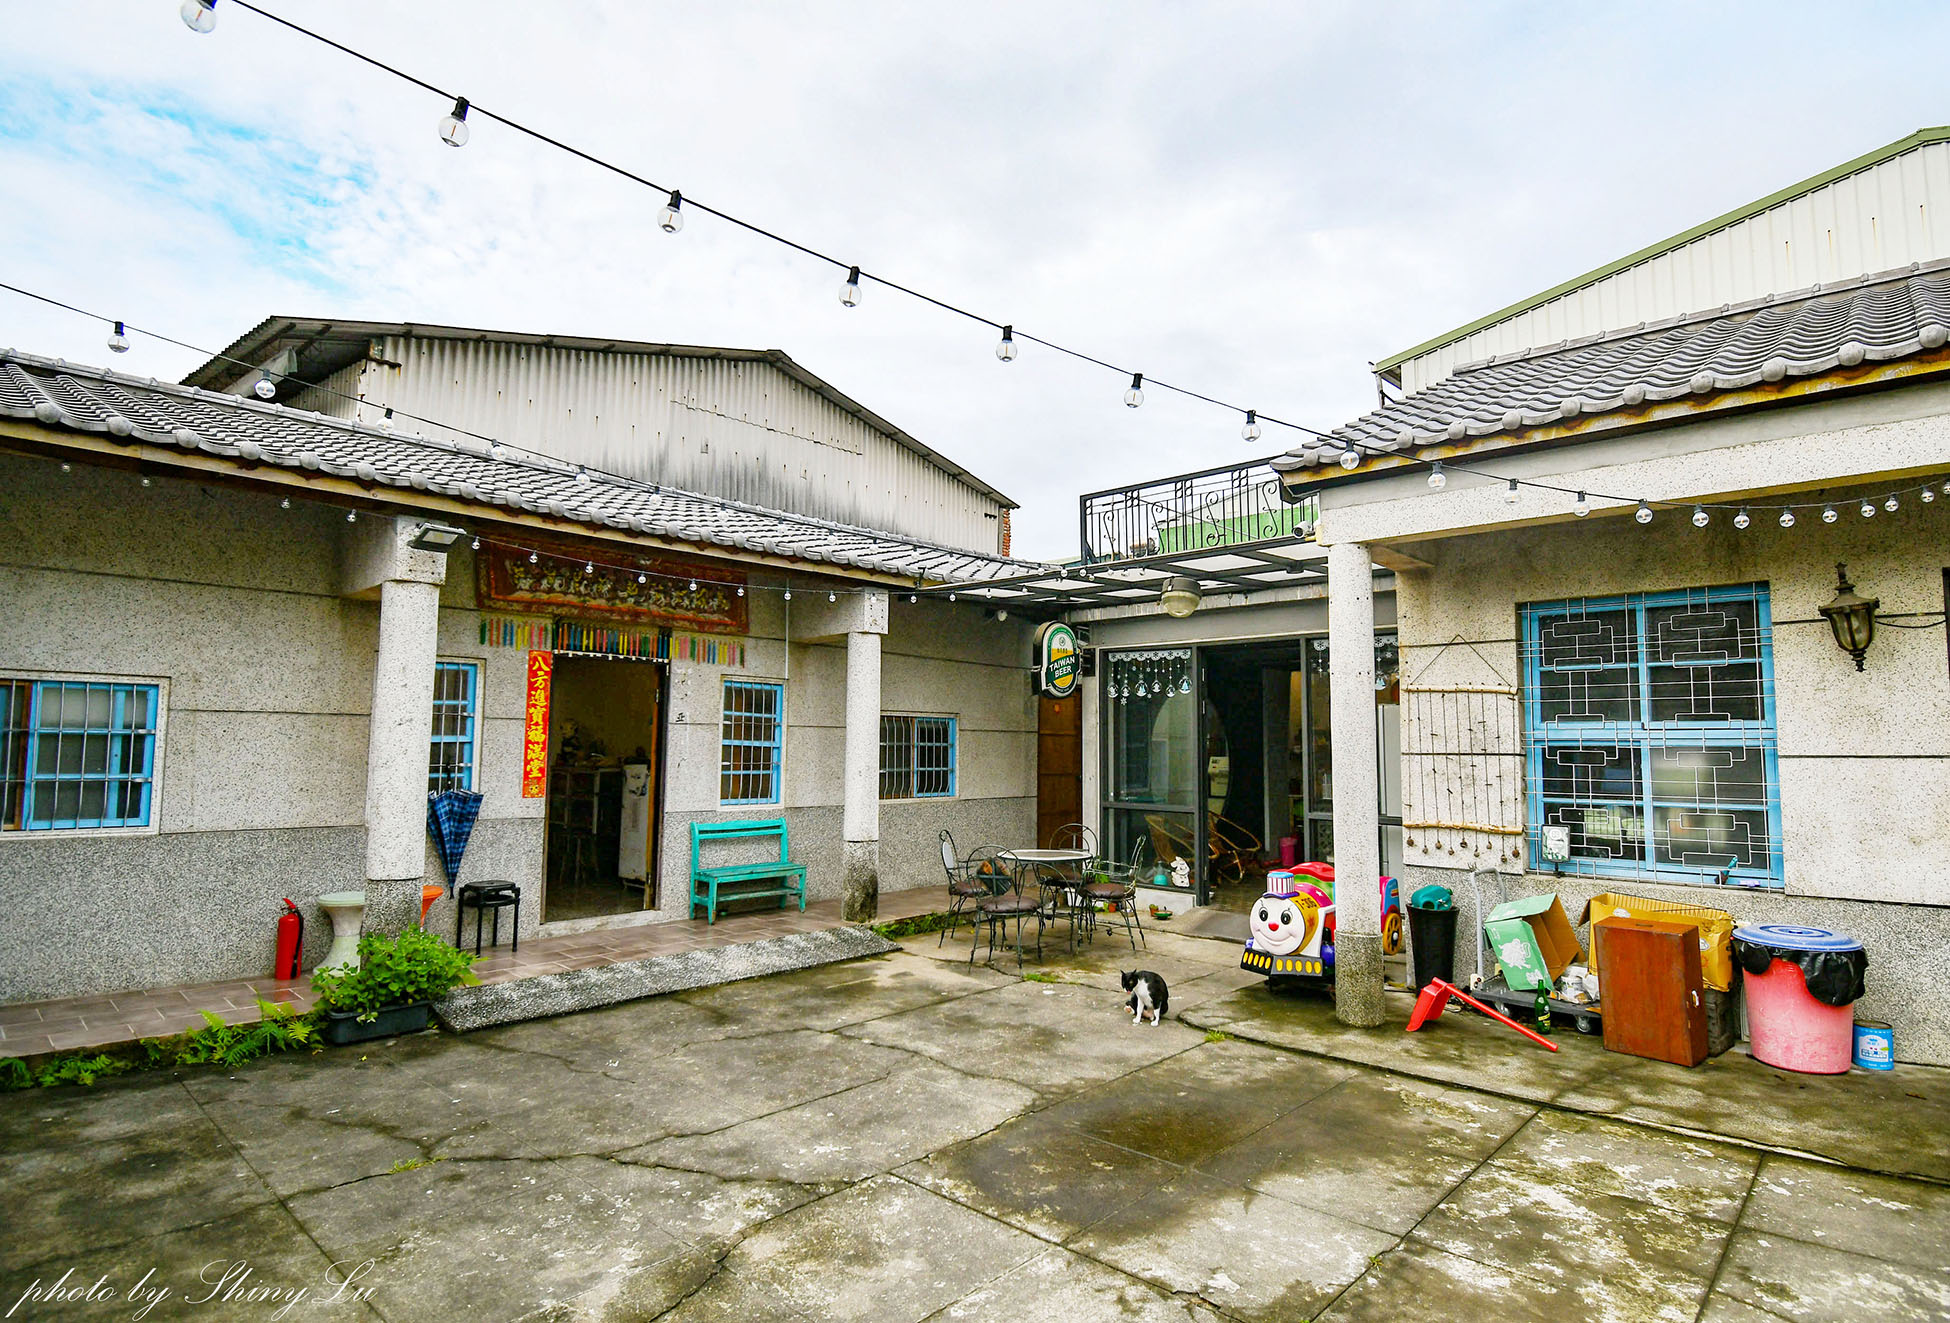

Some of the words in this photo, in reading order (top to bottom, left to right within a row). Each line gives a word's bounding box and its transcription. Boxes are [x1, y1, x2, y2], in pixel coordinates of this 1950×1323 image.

[1049, 656, 1075, 672] TAIWAN
[1055, 665, 1072, 678] BEER
[527, 655, 550, 778] 八方進寶福滿堂
